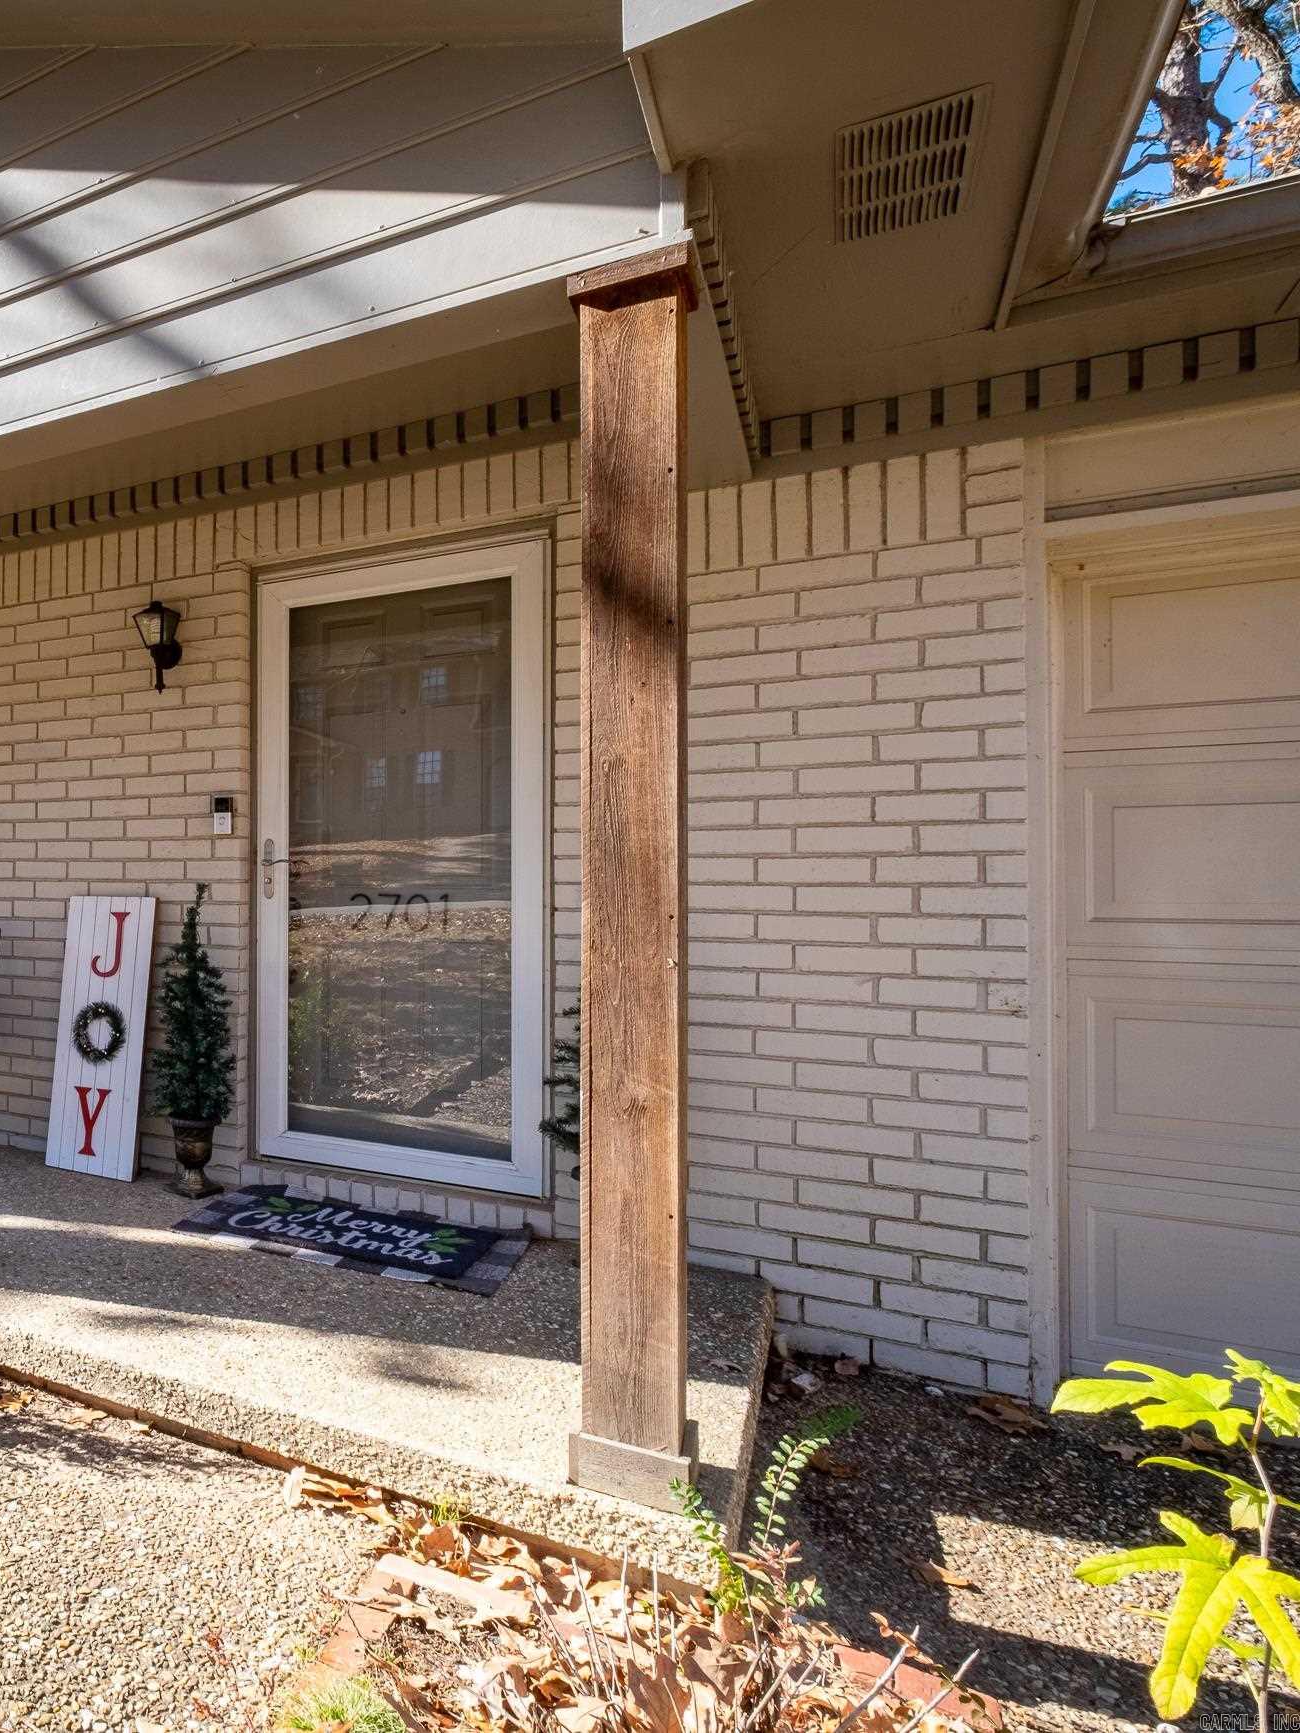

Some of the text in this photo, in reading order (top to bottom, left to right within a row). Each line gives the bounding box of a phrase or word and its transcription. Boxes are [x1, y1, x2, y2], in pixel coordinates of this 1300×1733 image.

[350, 893, 449, 933] 2701
[227, 1211, 452, 1265] Christmas
[286, 1207, 438, 1248] Merry
